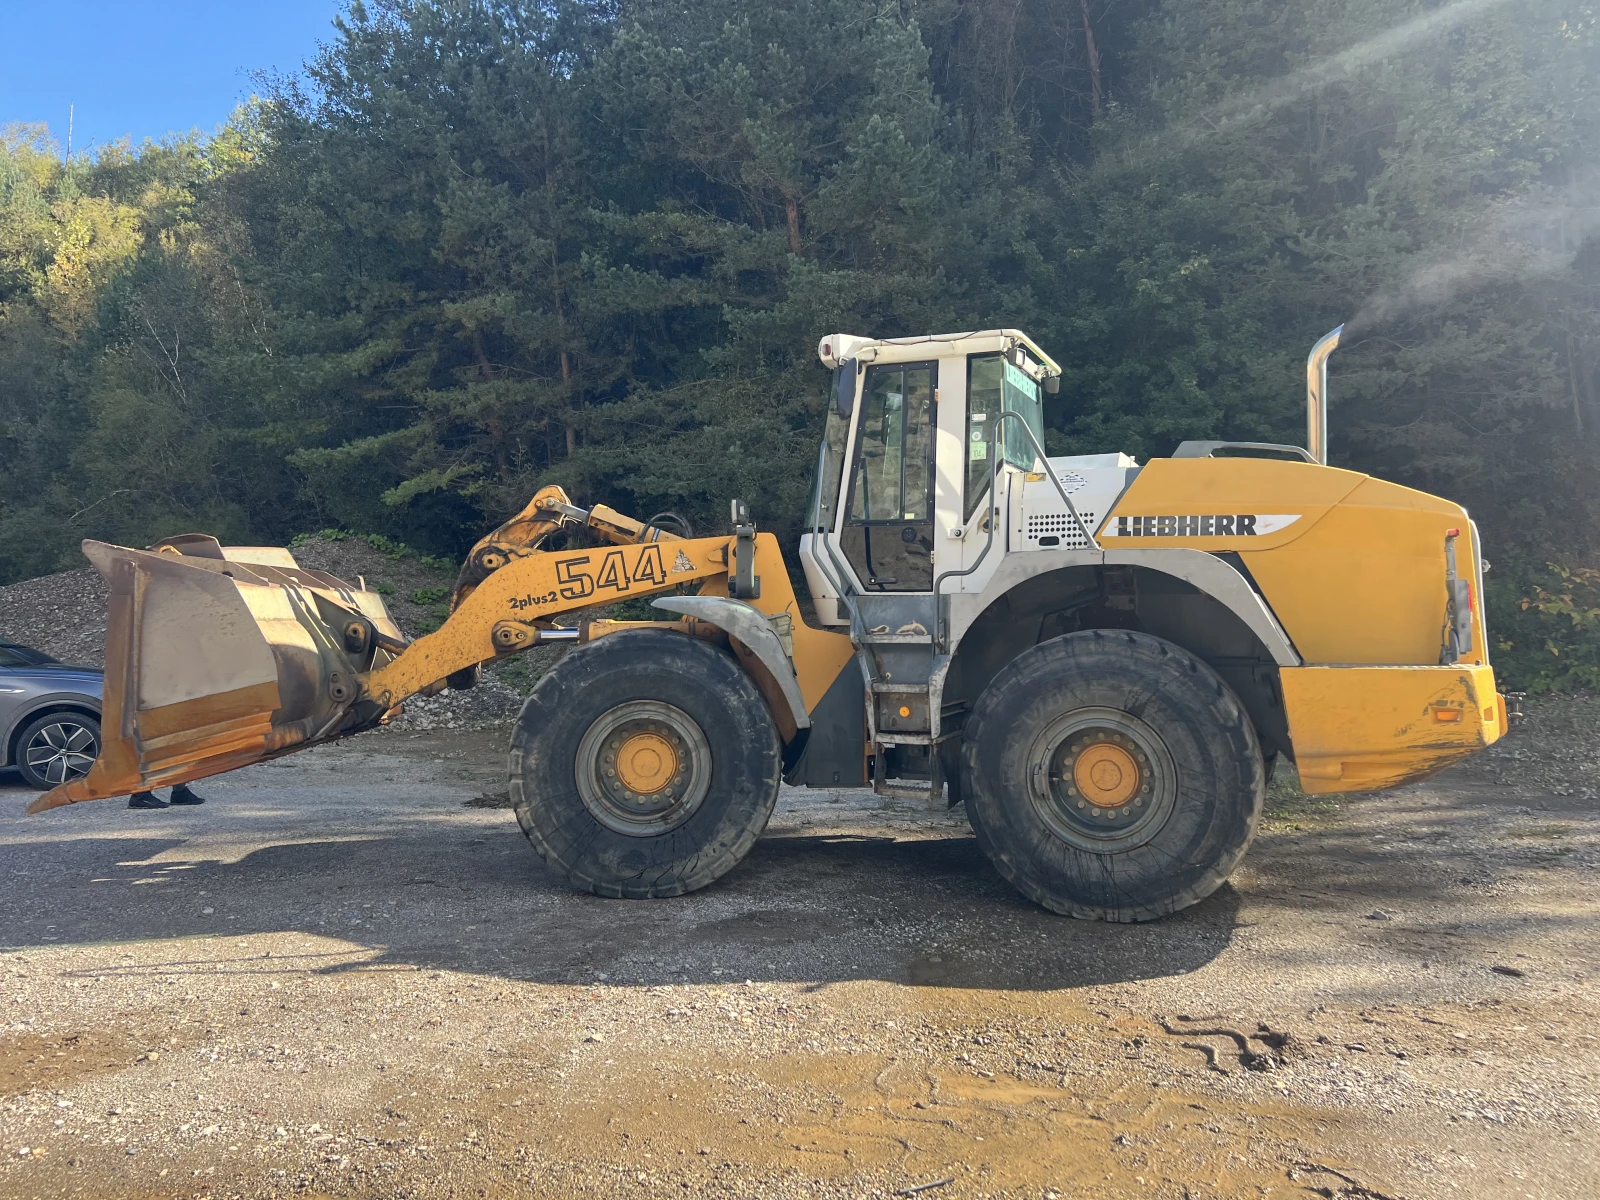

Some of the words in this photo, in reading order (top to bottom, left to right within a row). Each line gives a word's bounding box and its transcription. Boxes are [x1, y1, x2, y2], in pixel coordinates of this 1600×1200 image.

[1117, 514, 1257, 537] LIEBHERR
[509, 591, 558, 610] 2plus2
[555, 544, 668, 600] 544
